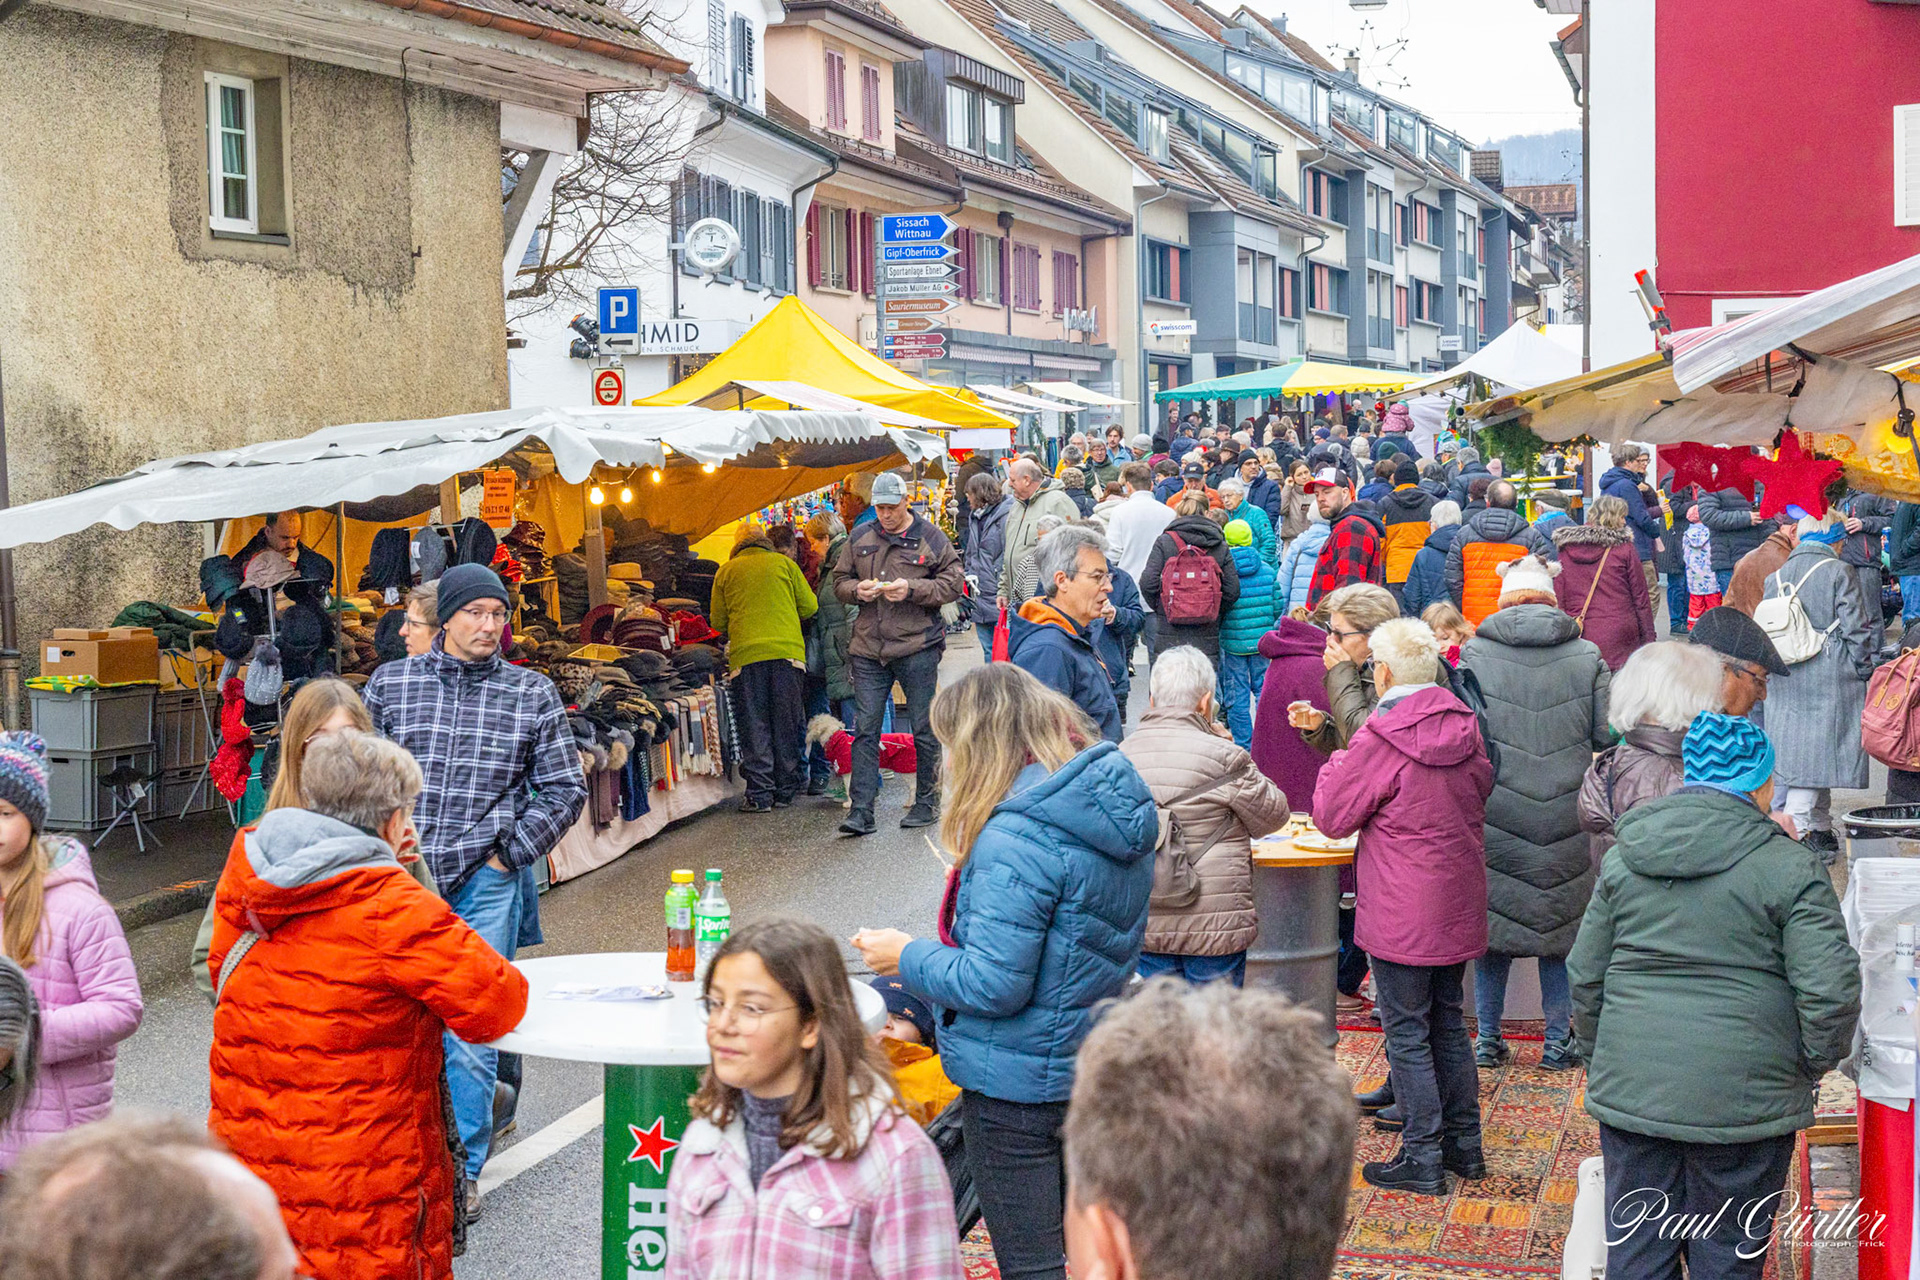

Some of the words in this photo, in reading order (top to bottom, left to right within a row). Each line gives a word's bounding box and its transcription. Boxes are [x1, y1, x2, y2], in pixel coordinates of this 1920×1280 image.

[896, 217, 929, 228] Sissach
[895, 229, 931, 238] Wittnau
[886, 247, 940, 259] Gipf-Oberfrick
[889, 266, 923, 278] Sportanlage
[925, 266, 942, 275] Ebnet
[888, 302, 941, 311] Sauriermuseum
[610, 296, 629, 329] P
[1161, 323, 1192, 331] swisscom
[702, 917, 730, 932] Sprit
